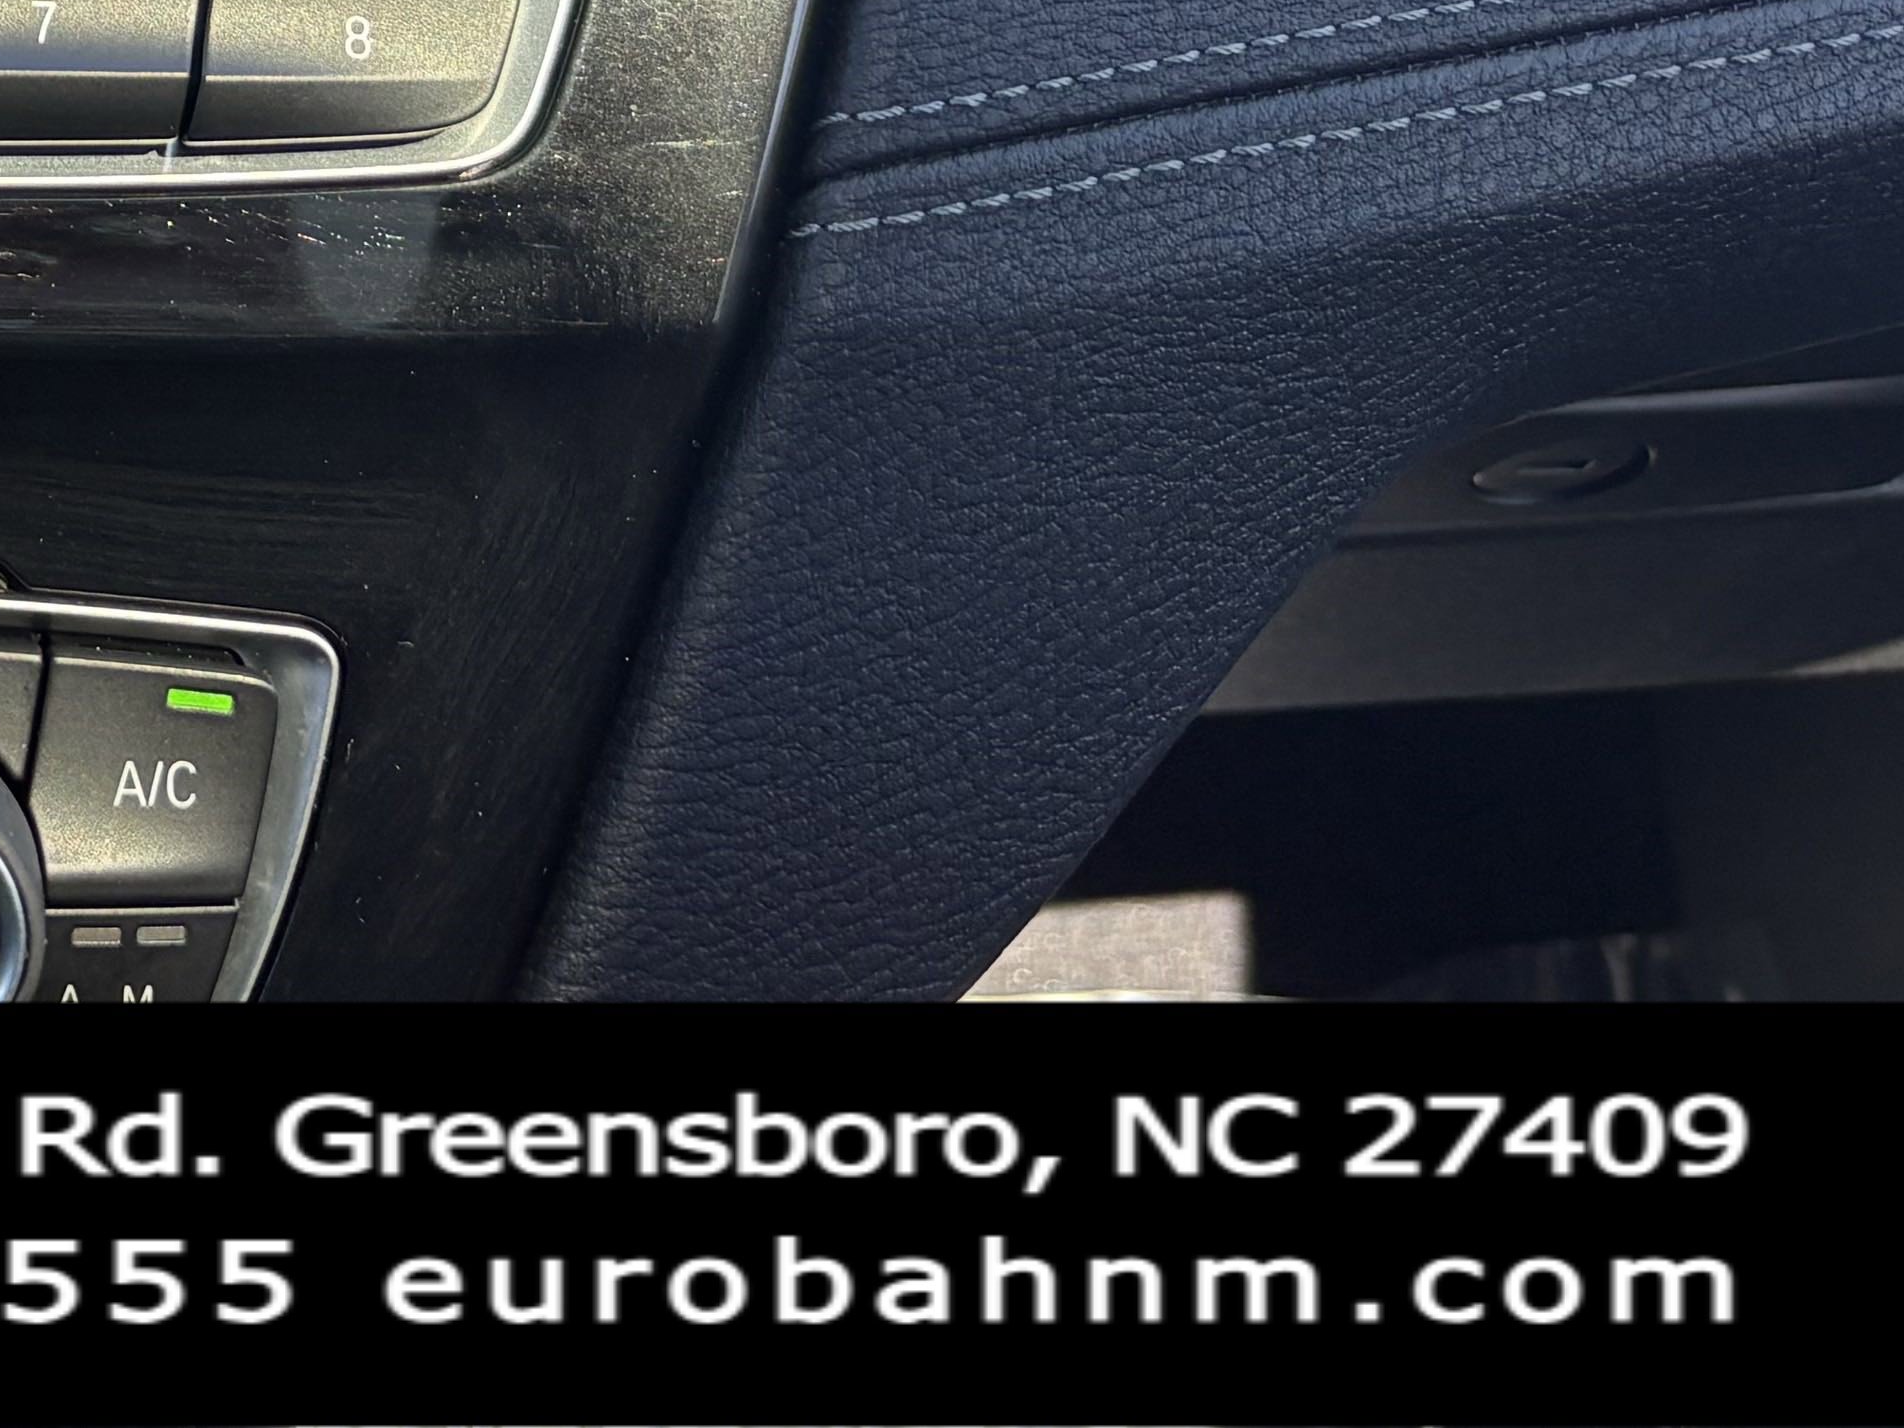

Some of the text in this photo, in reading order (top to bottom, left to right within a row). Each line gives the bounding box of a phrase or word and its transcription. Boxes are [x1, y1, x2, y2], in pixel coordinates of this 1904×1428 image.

[29, 0, 60, 46] 7
[344, 15, 379, 61] 8
[113, 760, 197, 810] A/C
